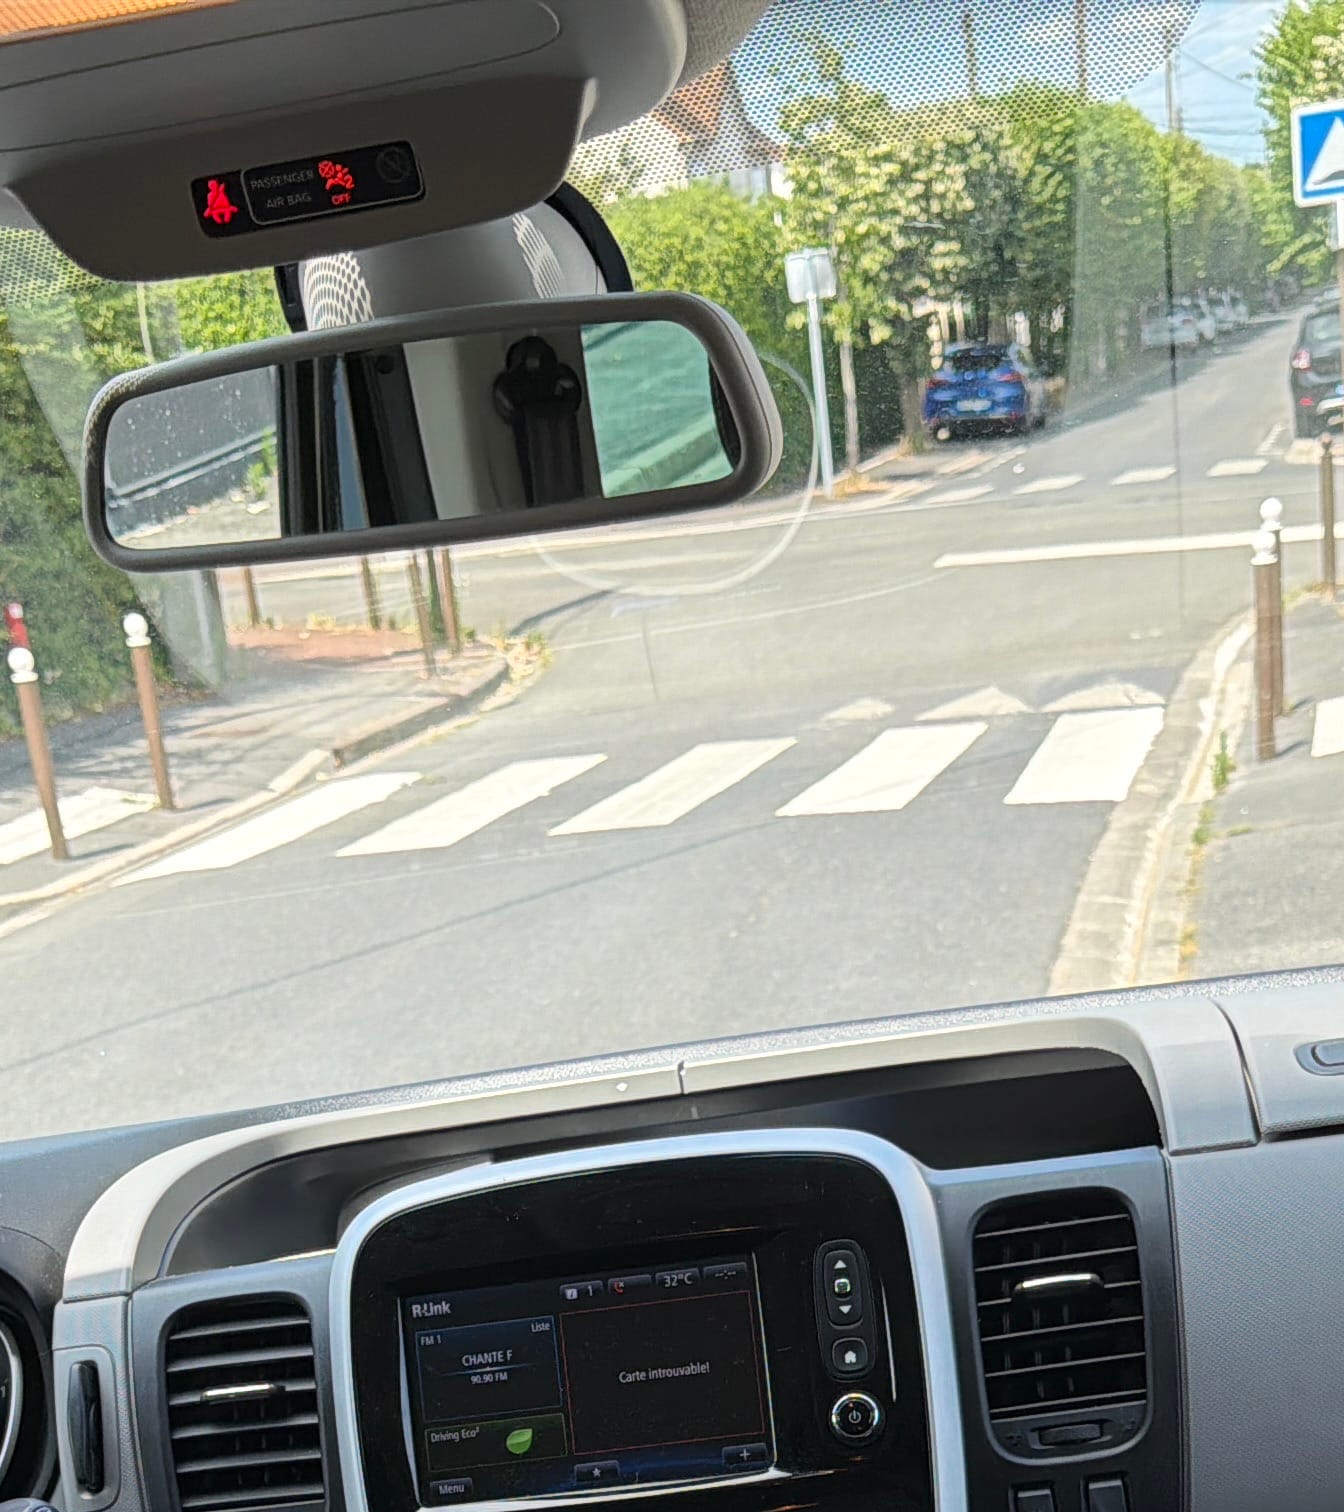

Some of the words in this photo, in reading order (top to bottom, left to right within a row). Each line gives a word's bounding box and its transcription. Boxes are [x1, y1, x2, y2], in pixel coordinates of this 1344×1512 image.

[250, 169, 314, 190] PASSENGER
[266, 197, 285, 209] AIR
[288, 192, 312, 206] BAG
[331, 192, 351, 205] OFF
[664, 1271, 694, 1288] 32°C
[530, 1321, 550, 1333] Liste
[420, 1335, 435, 1347] FM
[461, 1350, 504, 1367] CHANTE
[506, 1349, 513, 1361] F
[470, 1373, 494, 1385] 90.90
[495, 1371, 509, 1382] FM
[618, 1368, 647, 1384] Carte
[648, 1361, 710, 1380] introuvable!
[430, 1430, 460, 1443] Driving
[438, 1483, 465, 1495] Menu
